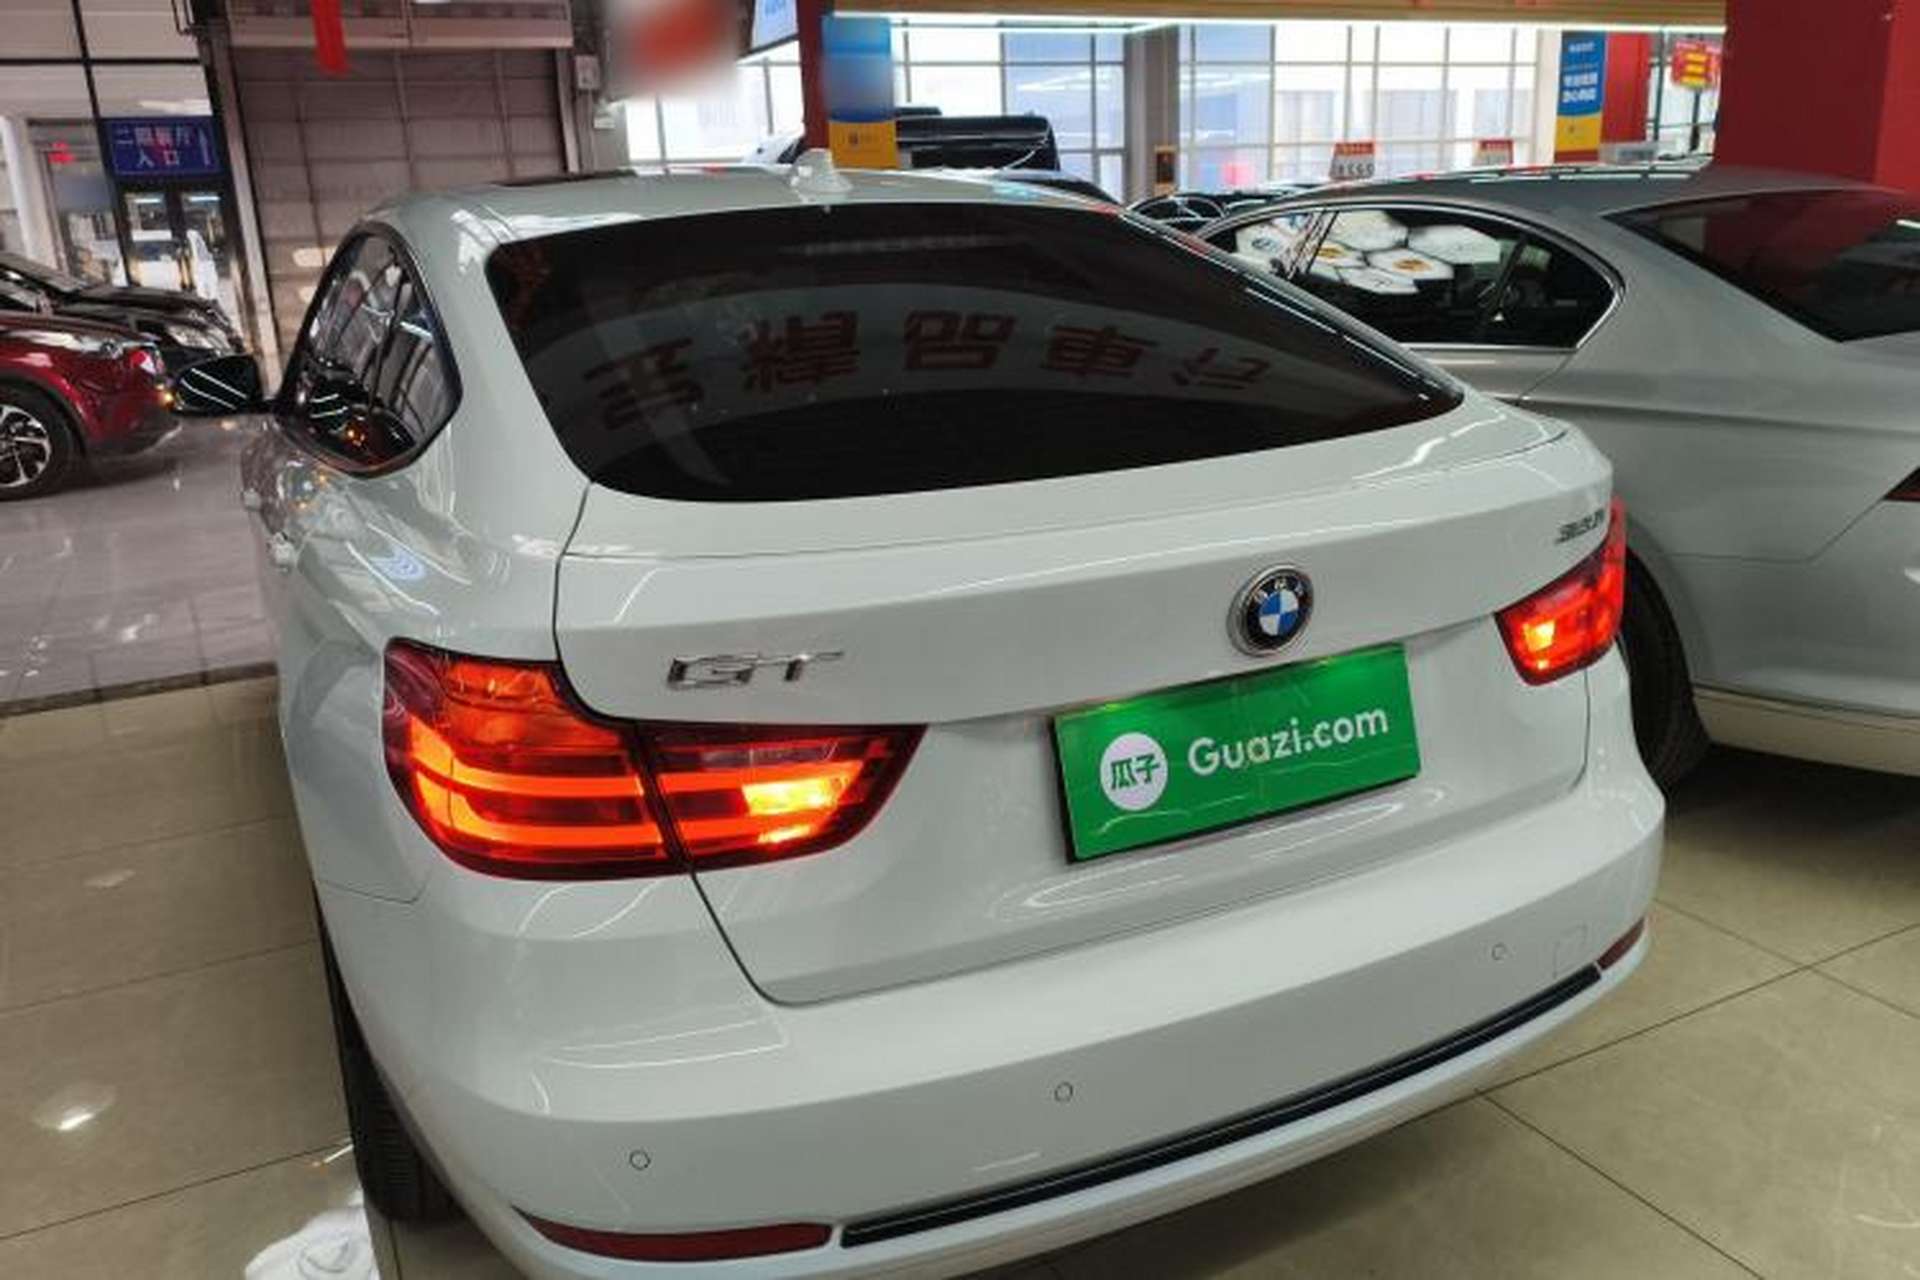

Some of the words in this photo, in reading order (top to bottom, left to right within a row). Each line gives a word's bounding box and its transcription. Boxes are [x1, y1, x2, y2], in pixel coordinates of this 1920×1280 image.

[667, 650, 844, 690] GT
[1187, 707, 1389, 776] Guazi.com
[1109, 752, 1161, 791] 瓜子
